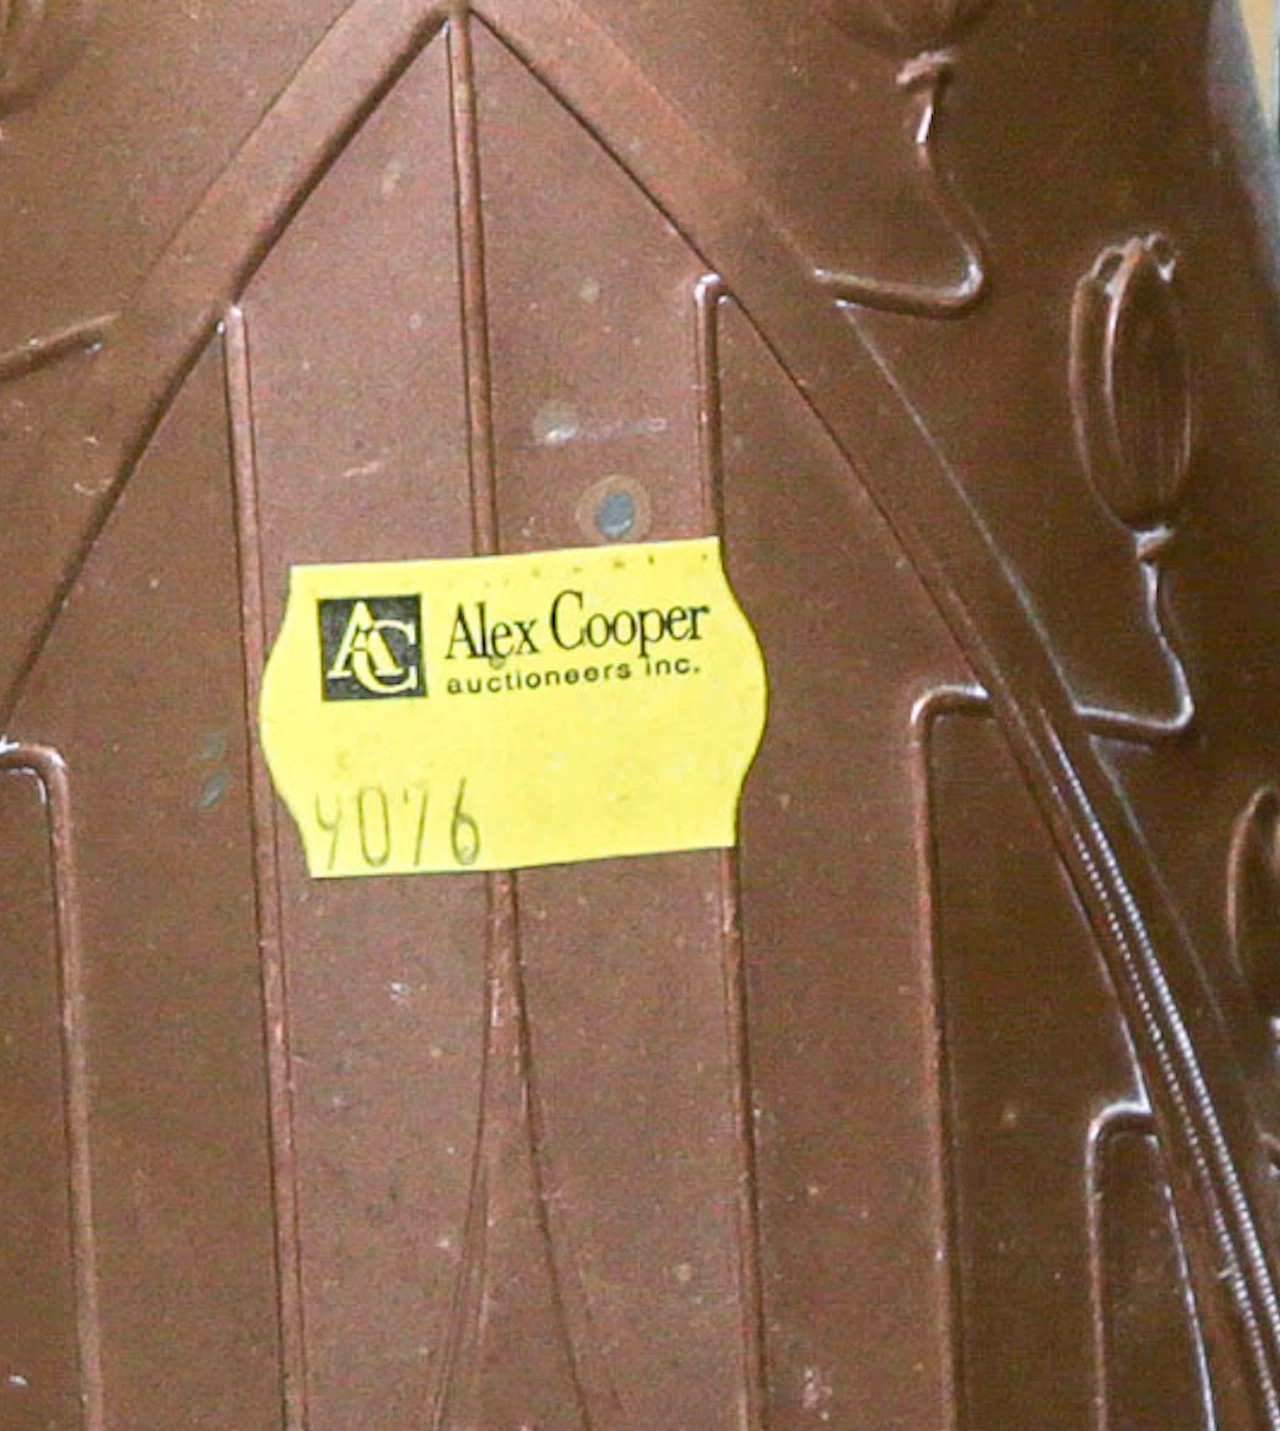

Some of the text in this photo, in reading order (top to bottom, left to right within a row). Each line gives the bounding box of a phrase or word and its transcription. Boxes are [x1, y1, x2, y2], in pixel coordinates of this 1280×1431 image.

[444, 589, 711, 661] Alex Cooper
[446, 654, 701, 696] auctioneers inc.
